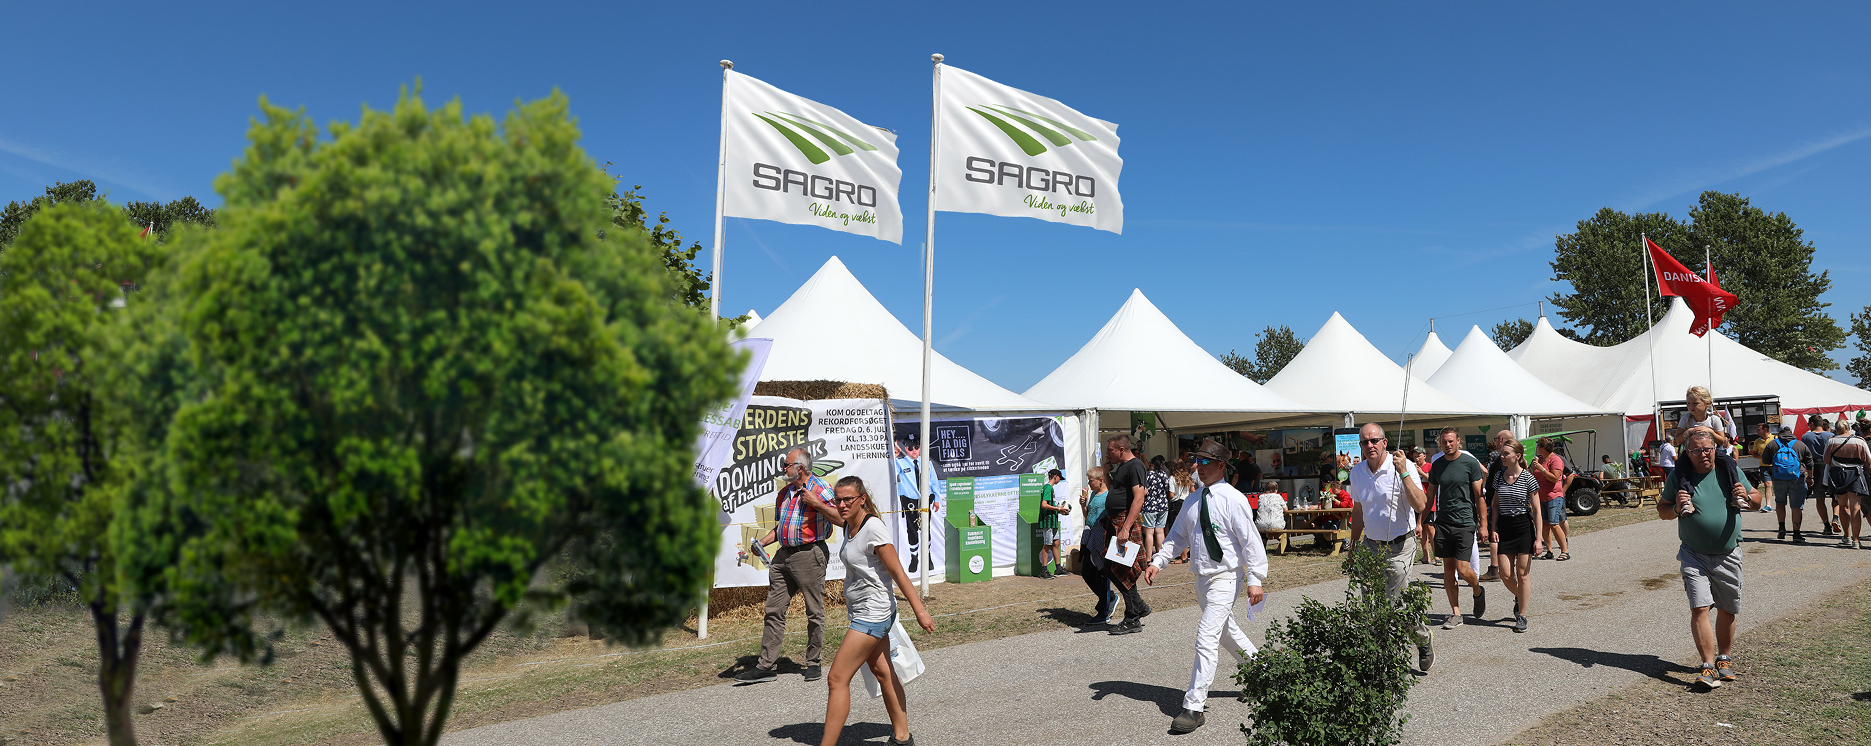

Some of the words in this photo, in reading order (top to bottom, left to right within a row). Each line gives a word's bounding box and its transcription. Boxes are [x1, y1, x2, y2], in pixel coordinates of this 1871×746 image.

[752, 162, 877, 208] SAGRO
[965, 156, 1096, 198] SAGRO
[808, 202, 838, 219] Viden
[839, 213, 850, 227] og
[851, 210, 877, 224] vækst
[1023, 194, 1054, 210] Viden
[1056, 204, 1067, 217] og
[1069, 200, 1095, 214] vækst
[739, 408, 809, 430] ERDENS
[818, 417, 888, 426] REKORDFORSØGET
[856, 408, 883, 416] DELTAG
[825, 427, 857, 435] FREDAG
[874, 426, 888, 434] JULI
[736, 429, 806, 460] STØRSTE
[953, 438, 967, 448] DIG
[856, 452, 891, 460] HERNING
[722, 494, 736, 512] af
[738, 479, 773, 505] halm
